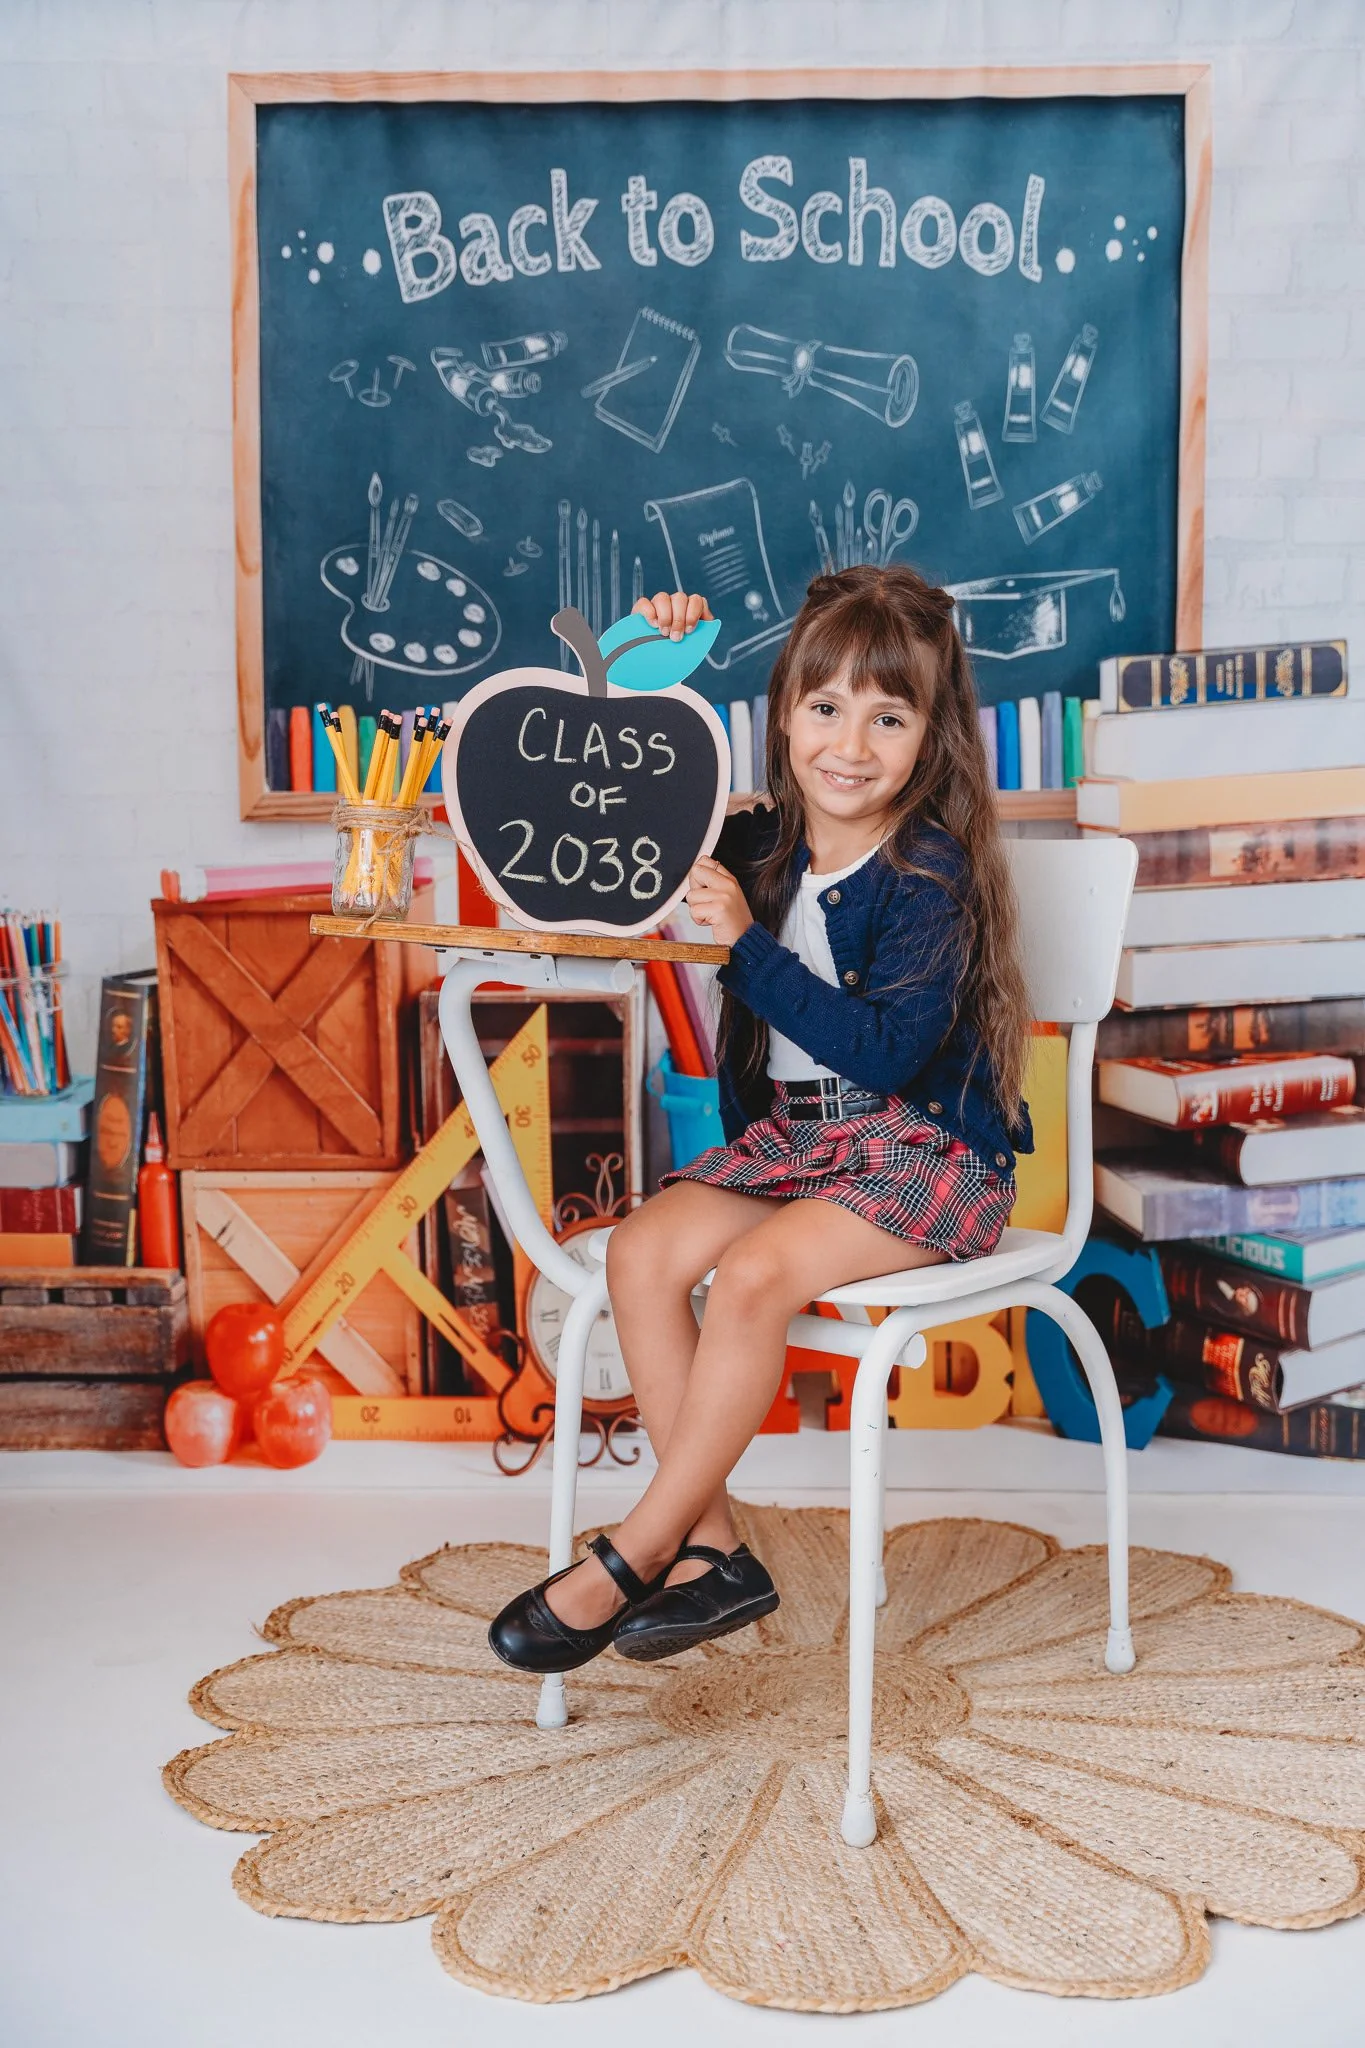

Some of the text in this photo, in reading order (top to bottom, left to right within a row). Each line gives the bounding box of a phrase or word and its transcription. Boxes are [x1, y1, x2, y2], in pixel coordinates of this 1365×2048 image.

[382, 155, 1046, 304] Back to School
[518, 707, 676, 776] CLASS
[569, 781, 628, 815] OF
[498, 818, 664, 901] 2038
[521, 1043, 542, 1069] 50
[514, 1105, 531, 1128] 30
[397, 1195, 418, 1219] 30
[334, 1271, 355, 1296] 20
[360, 1405, 381, 1424] 20
[454, 1406, 472, 1424] 10
